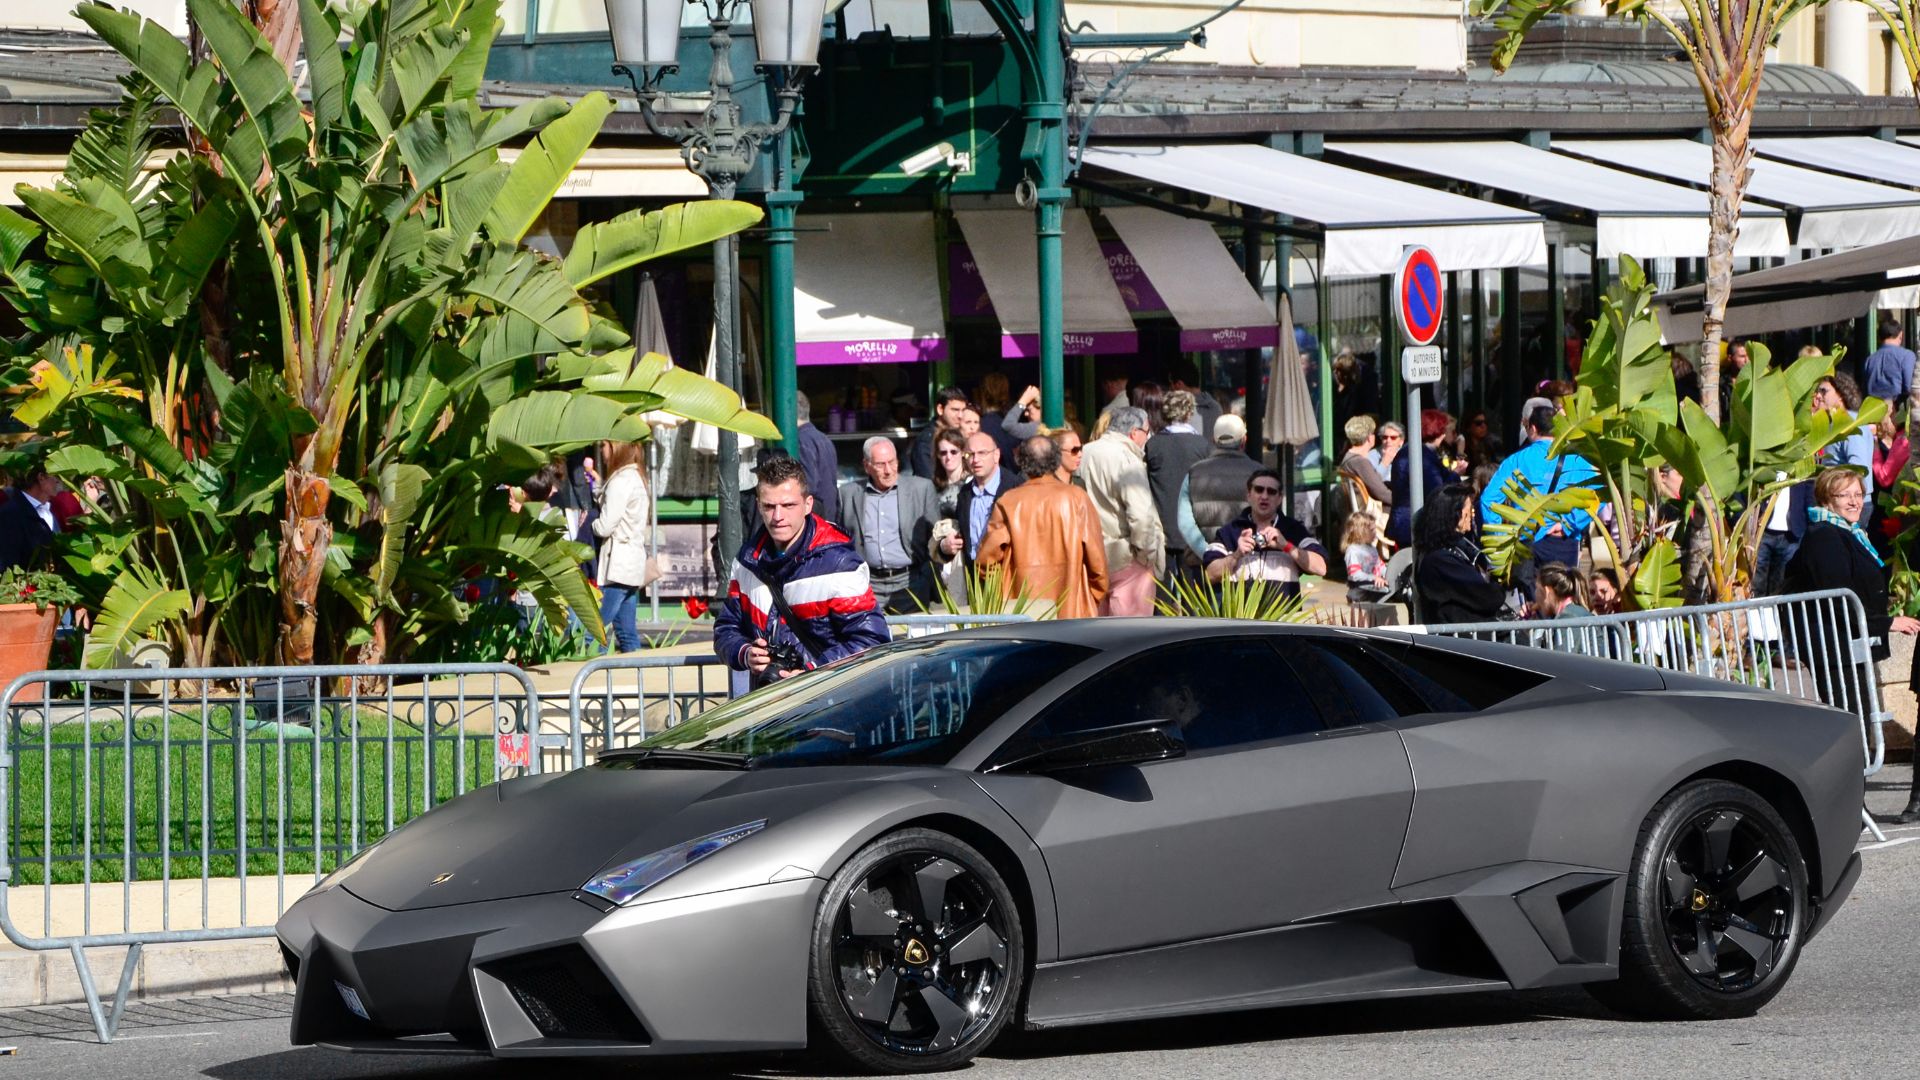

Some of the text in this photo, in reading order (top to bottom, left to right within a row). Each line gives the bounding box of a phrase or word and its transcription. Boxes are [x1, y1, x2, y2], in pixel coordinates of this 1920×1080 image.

[1063, 334, 1094, 347] RELLI'S
[844, 341, 897, 355] MORELLI'S
[1413, 353, 1437, 364] AUTORISE
[1410, 366, 1440, 377] 10 MINUTES
